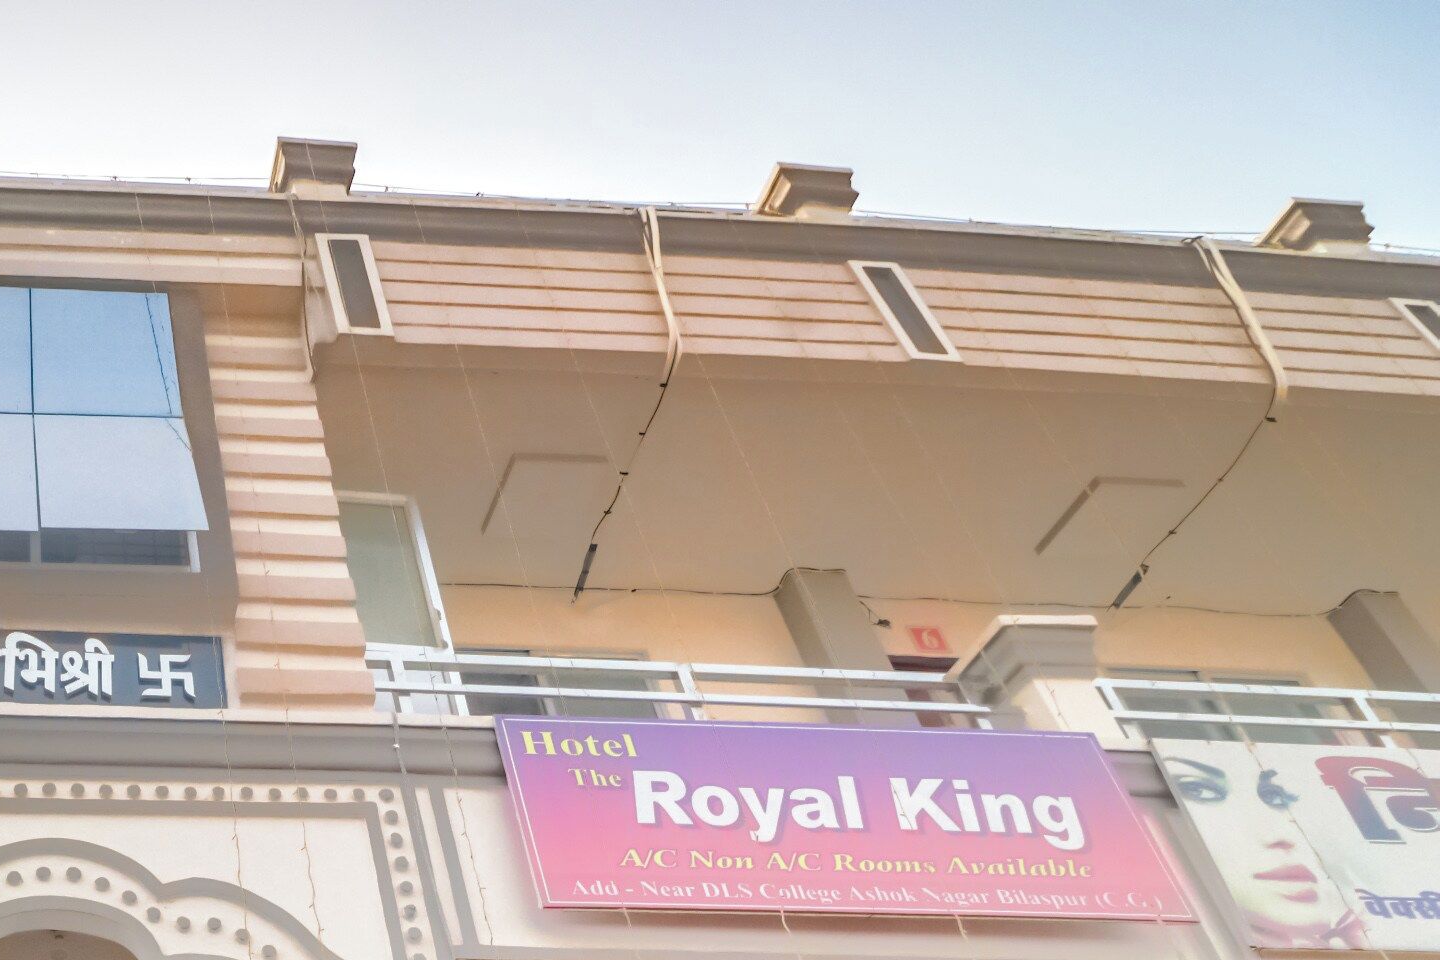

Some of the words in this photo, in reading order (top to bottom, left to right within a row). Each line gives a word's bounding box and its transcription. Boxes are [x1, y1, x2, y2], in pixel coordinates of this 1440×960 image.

[521, 731, 638, 758] Hotel
[567, 768, 622, 788] The
[632, 770, 864, 843] Royal
[889, 777, 1085, 850] King
[620, 848, 677, 869] A/C
[689, 851, 755, 870] Non
[766, 852, 822, 872] A/C
[833, 854, 937, 874] Rooms
[946, 857, 1093, 879] Available
[572, 880, 619, 896] Add
[640, 881, 695, 898] Near
[702, 883, 753, 899] DLS
[759, 884, 841, 904] College
[849, 886, 918, 902] Ashok
[996, 890, 1088, 909] Bilaspur
